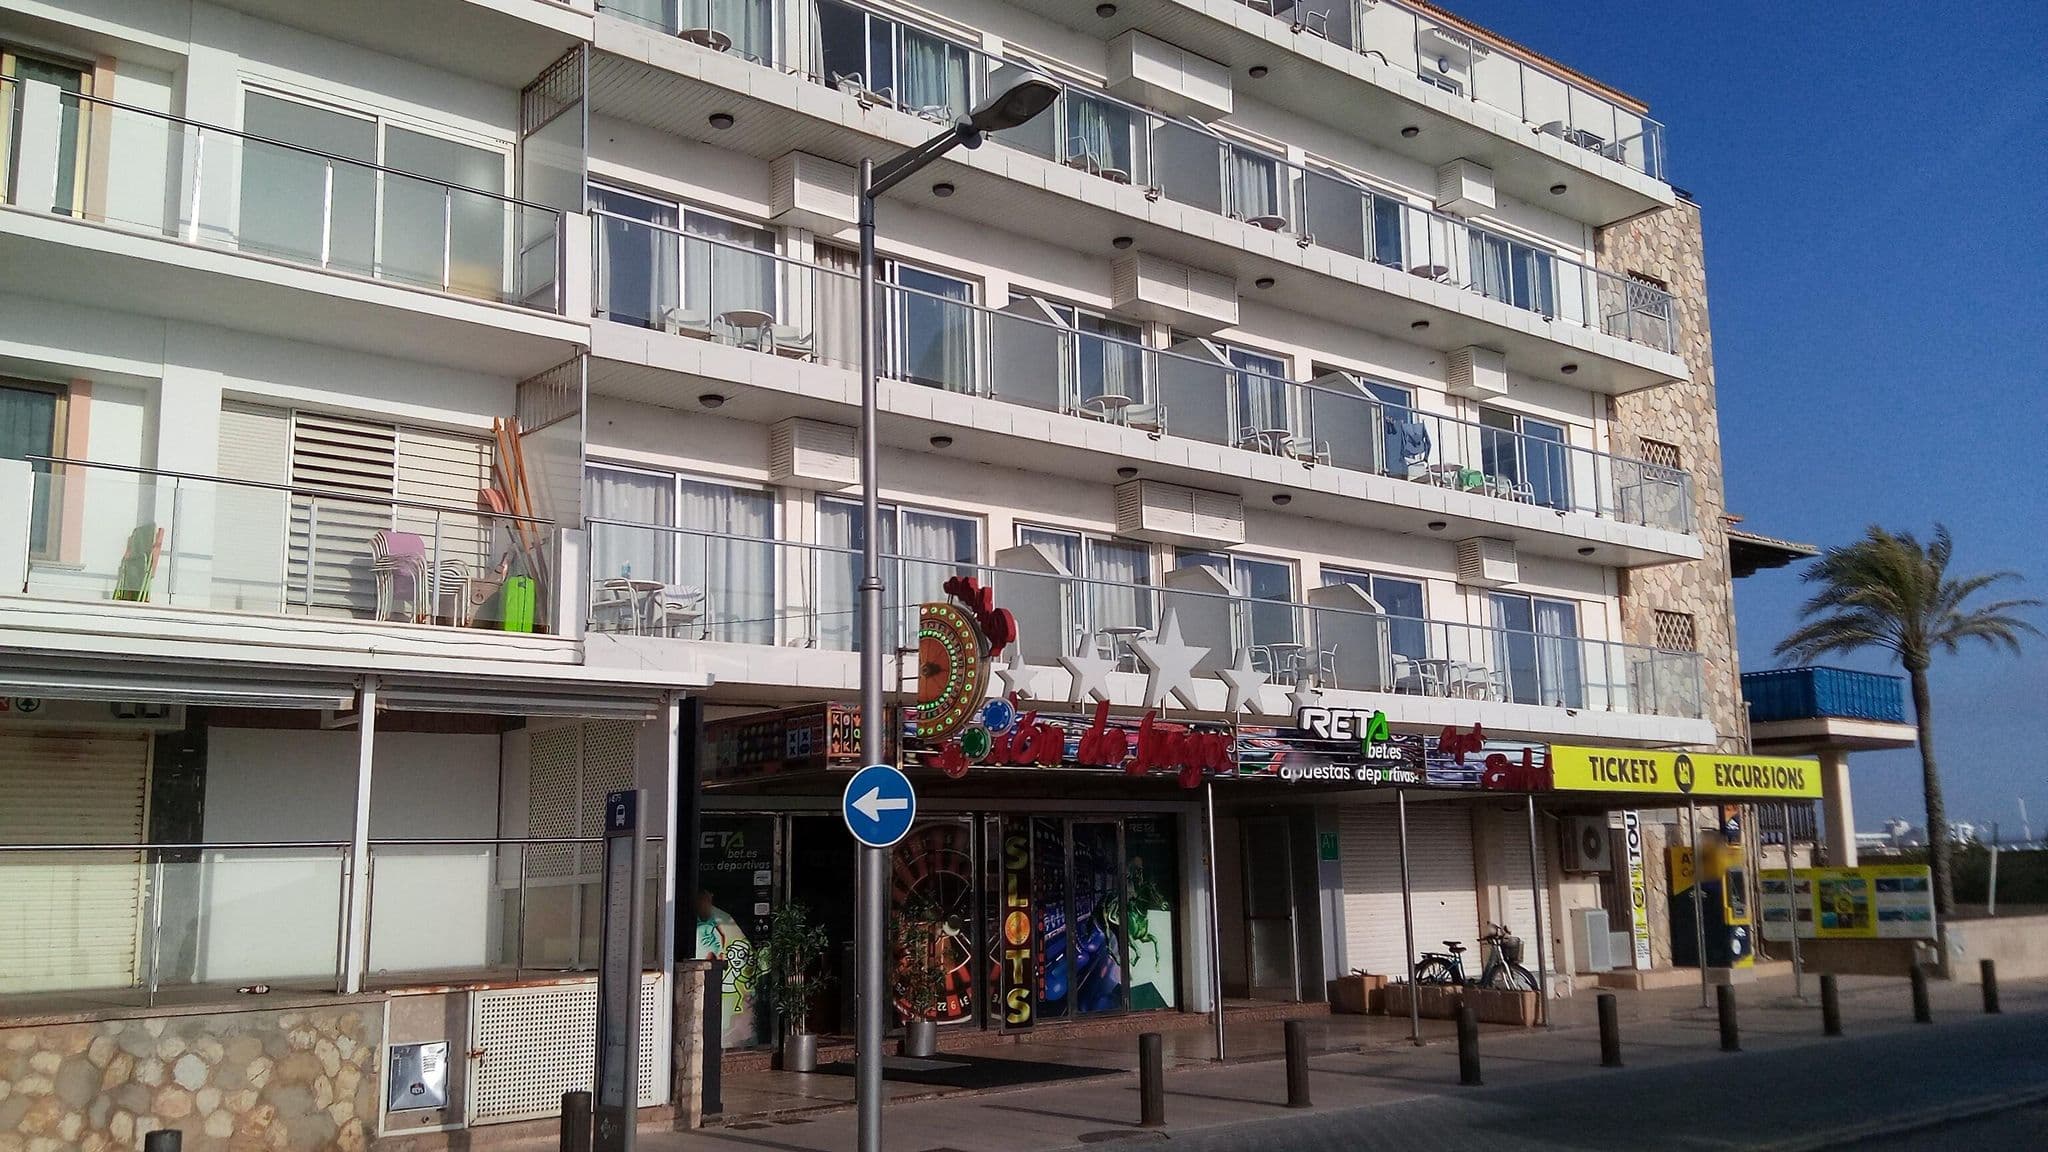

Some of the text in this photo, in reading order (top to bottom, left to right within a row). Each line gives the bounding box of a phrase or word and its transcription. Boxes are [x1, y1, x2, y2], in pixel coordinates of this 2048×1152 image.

[1299, 707, 1390, 754] RETA
[1367, 742, 1402, 760] bet.es
[1281, 763, 1417, 786] apuestas deportivas
[1588, 756, 1806, 790] TICKETS EXCURSIONS
[700, 831, 745, 849] ETA
[716, 858, 771, 872] deportivas
[1004, 835, 1031, 1024] SLOTS
